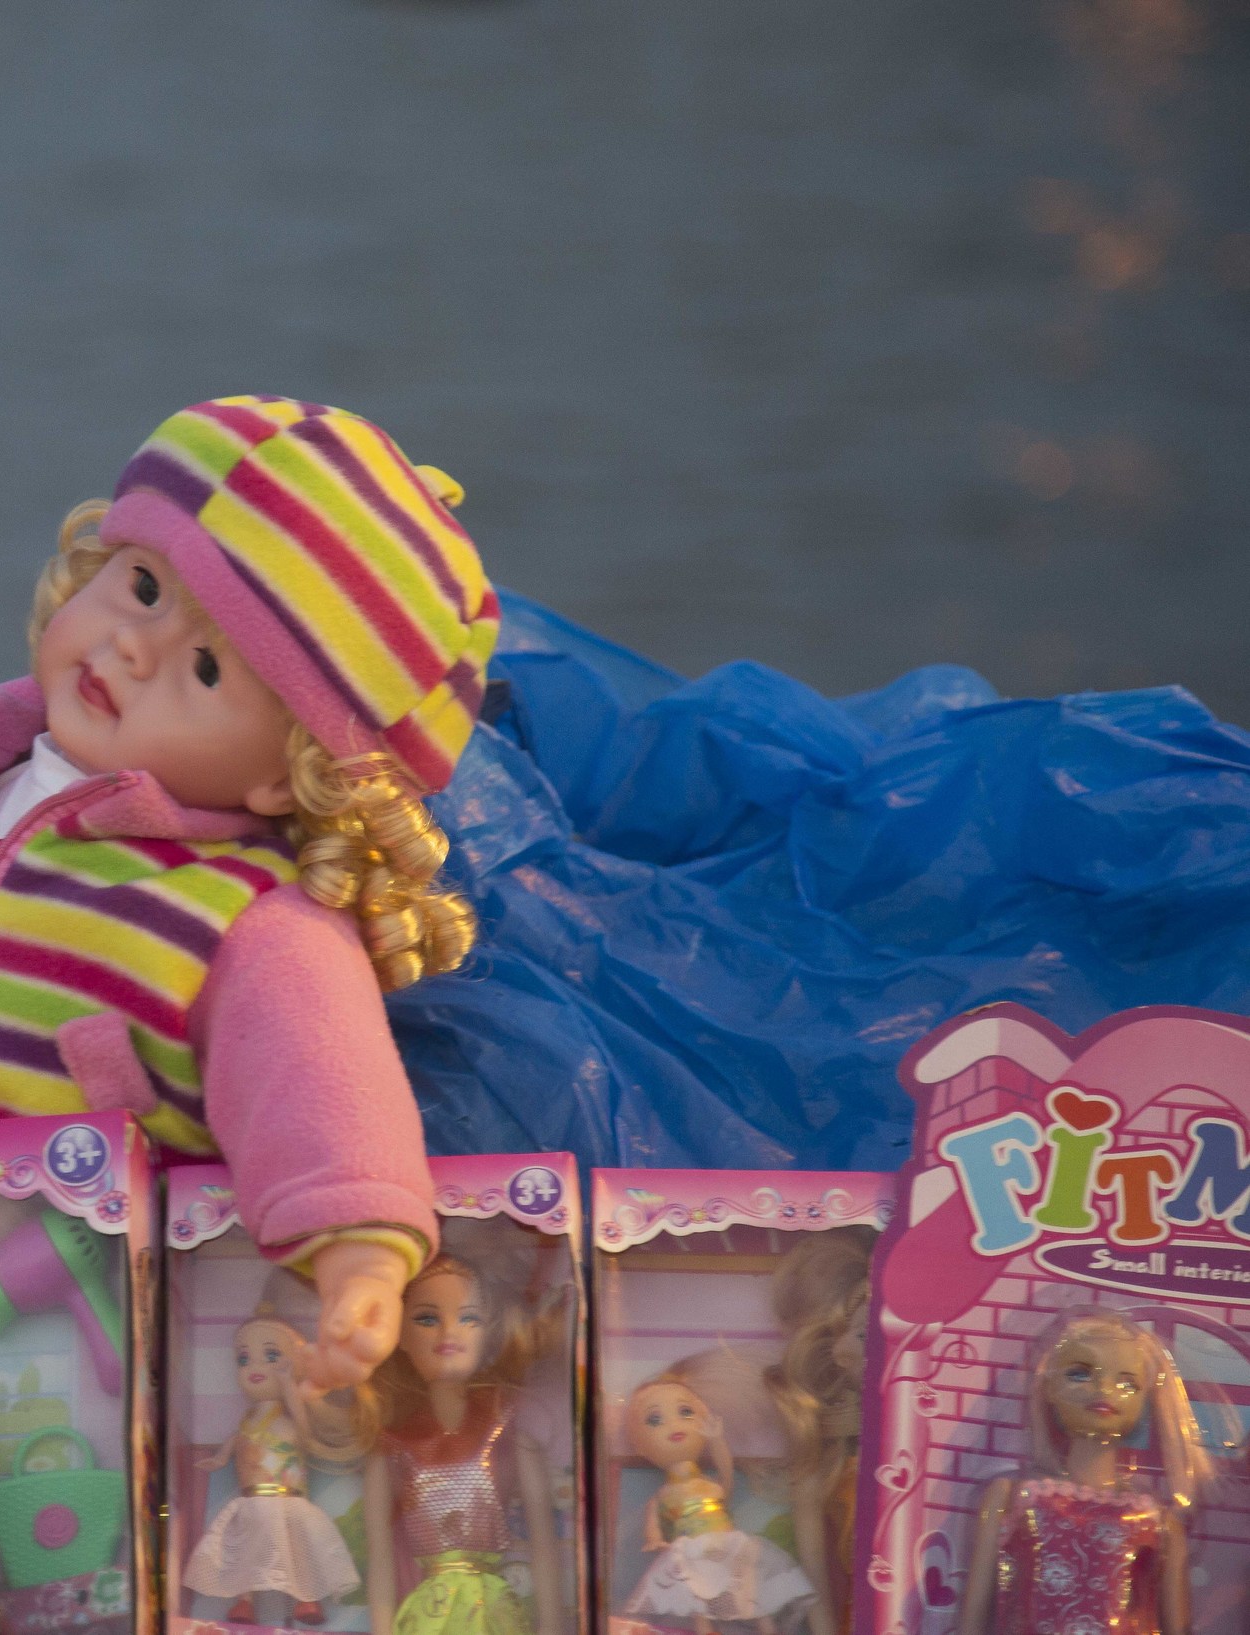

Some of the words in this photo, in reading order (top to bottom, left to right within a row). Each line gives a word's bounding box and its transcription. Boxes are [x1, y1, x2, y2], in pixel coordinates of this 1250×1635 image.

[56, 1141, 102, 1173] 3+
[516, 1179, 558, 1206] 3+
[1088, 1248, 1166, 1276] Small
